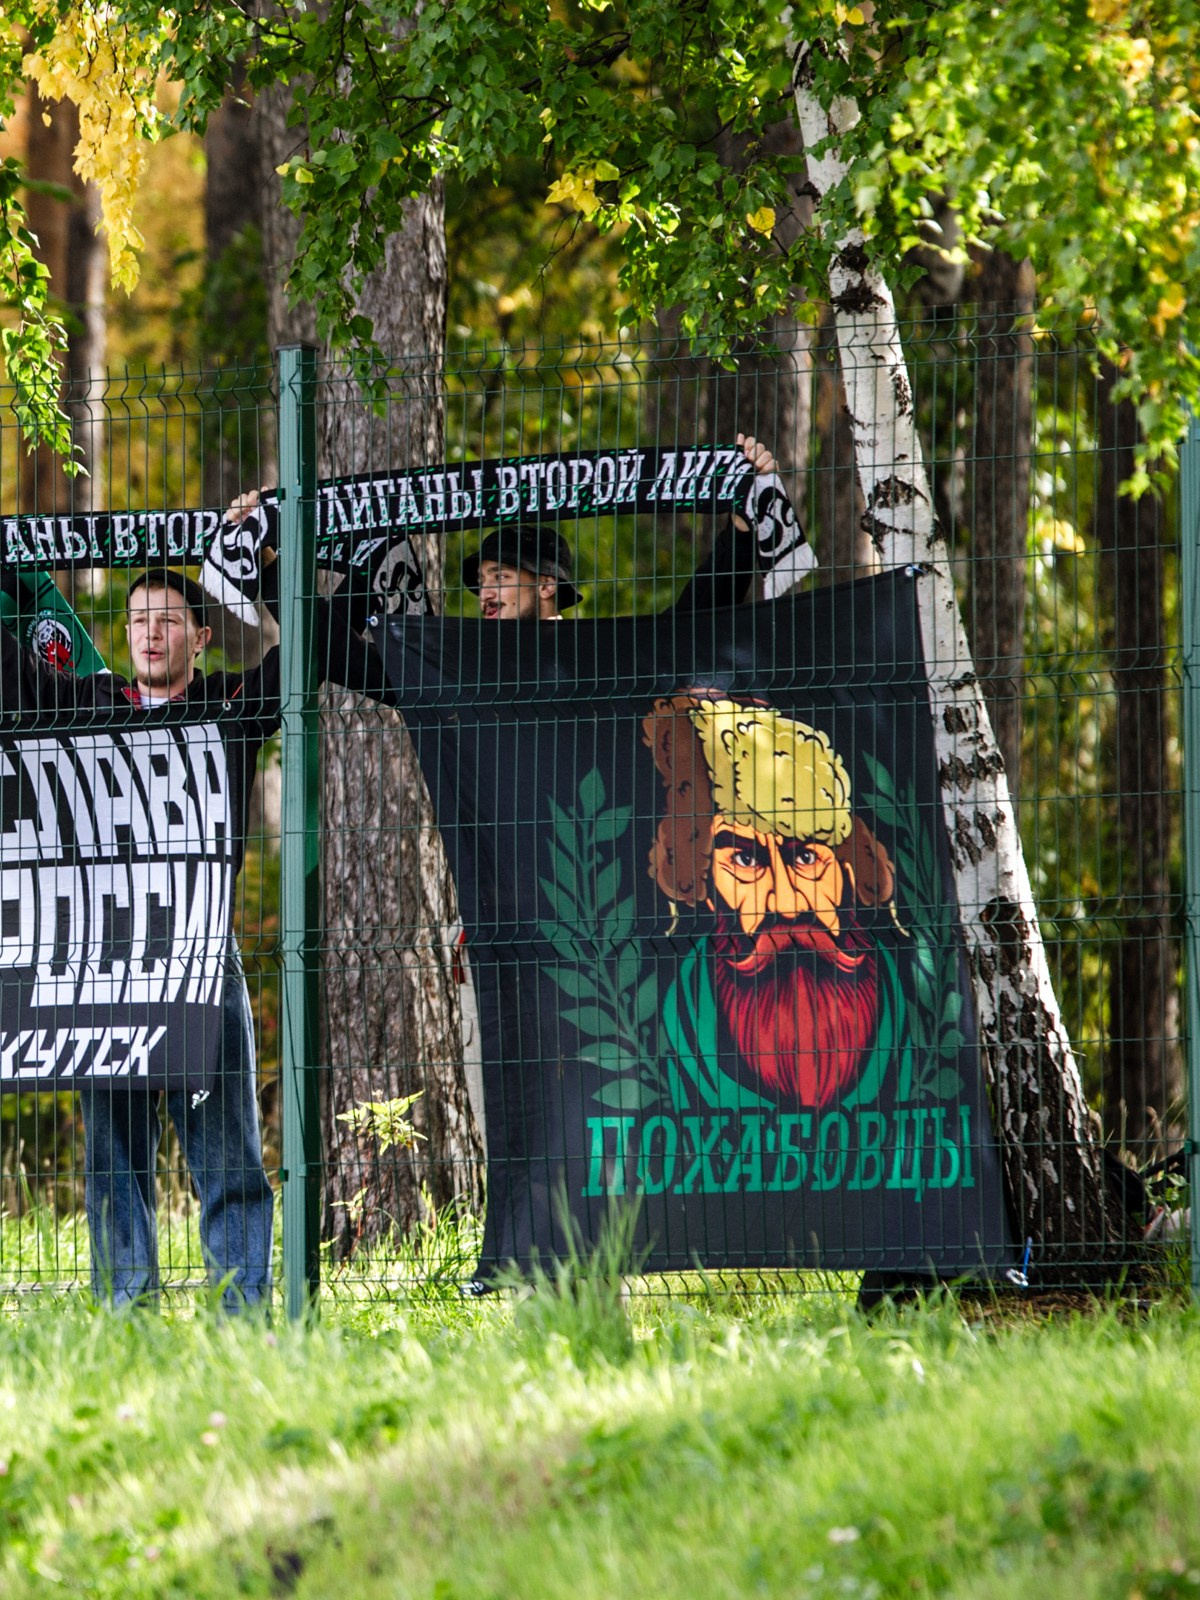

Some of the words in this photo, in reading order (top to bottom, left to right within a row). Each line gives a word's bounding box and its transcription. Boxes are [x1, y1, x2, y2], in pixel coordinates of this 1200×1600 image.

[112, 511, 219, 557] ВТОР
[317, 469, 487, 535] ЛИГАНЫ
[498, 449, 645, 515] ВТОРОЙ
[582, 1105, 976, 1203] ПОХАБОВЦЫ
